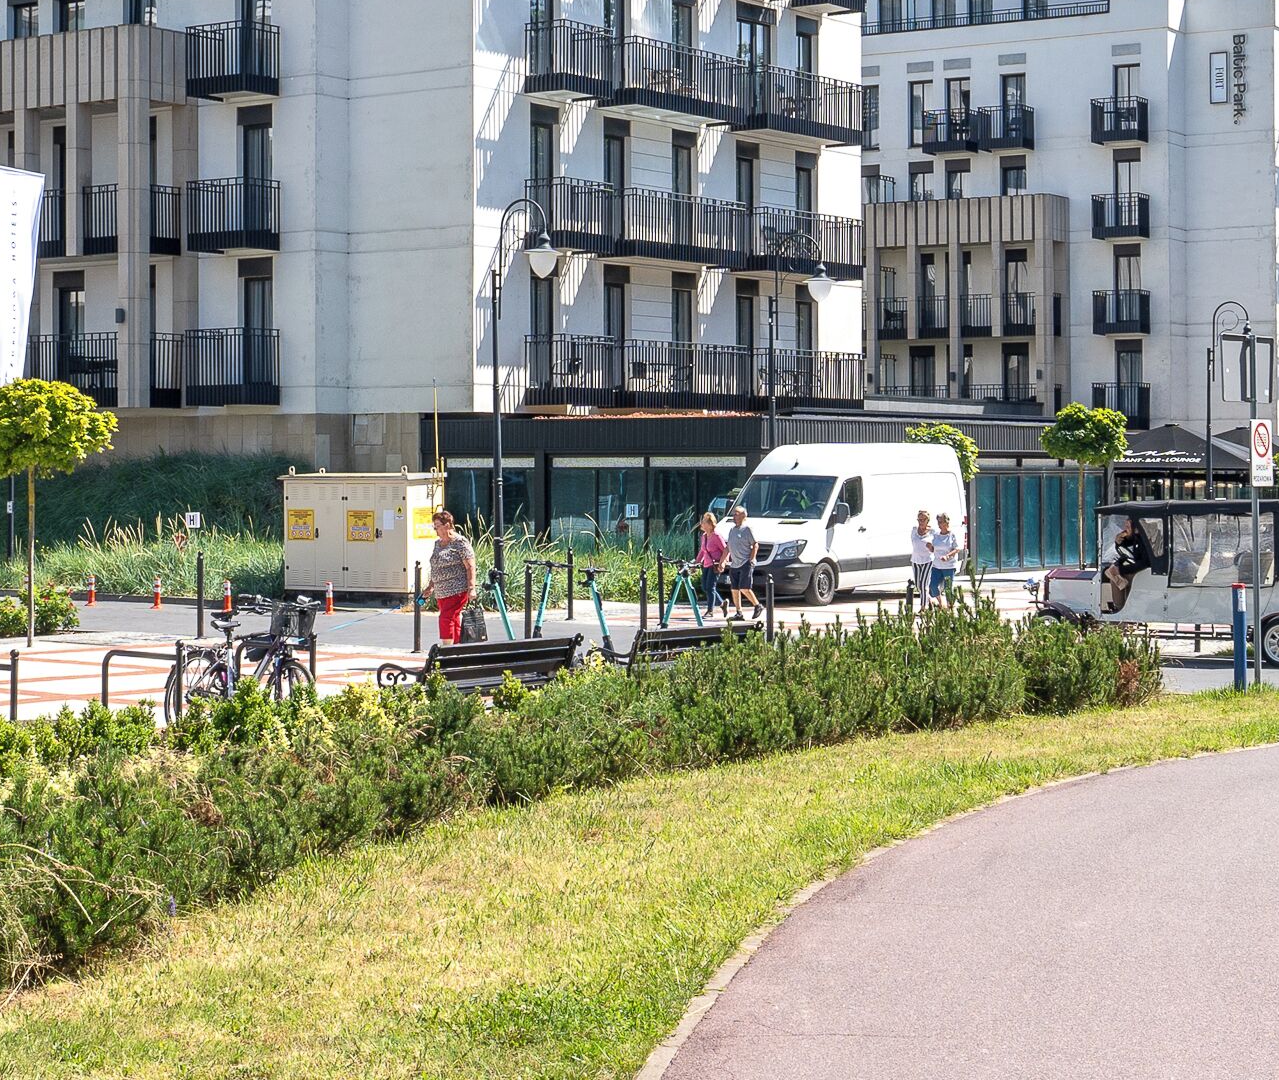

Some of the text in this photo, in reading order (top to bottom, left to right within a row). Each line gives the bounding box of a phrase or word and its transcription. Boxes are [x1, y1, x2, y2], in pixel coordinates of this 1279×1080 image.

[1233, 34, 1246, 79] Baltic
[1215, 67, 1224, 89] FORT
[189, 514, 195, 526] H
